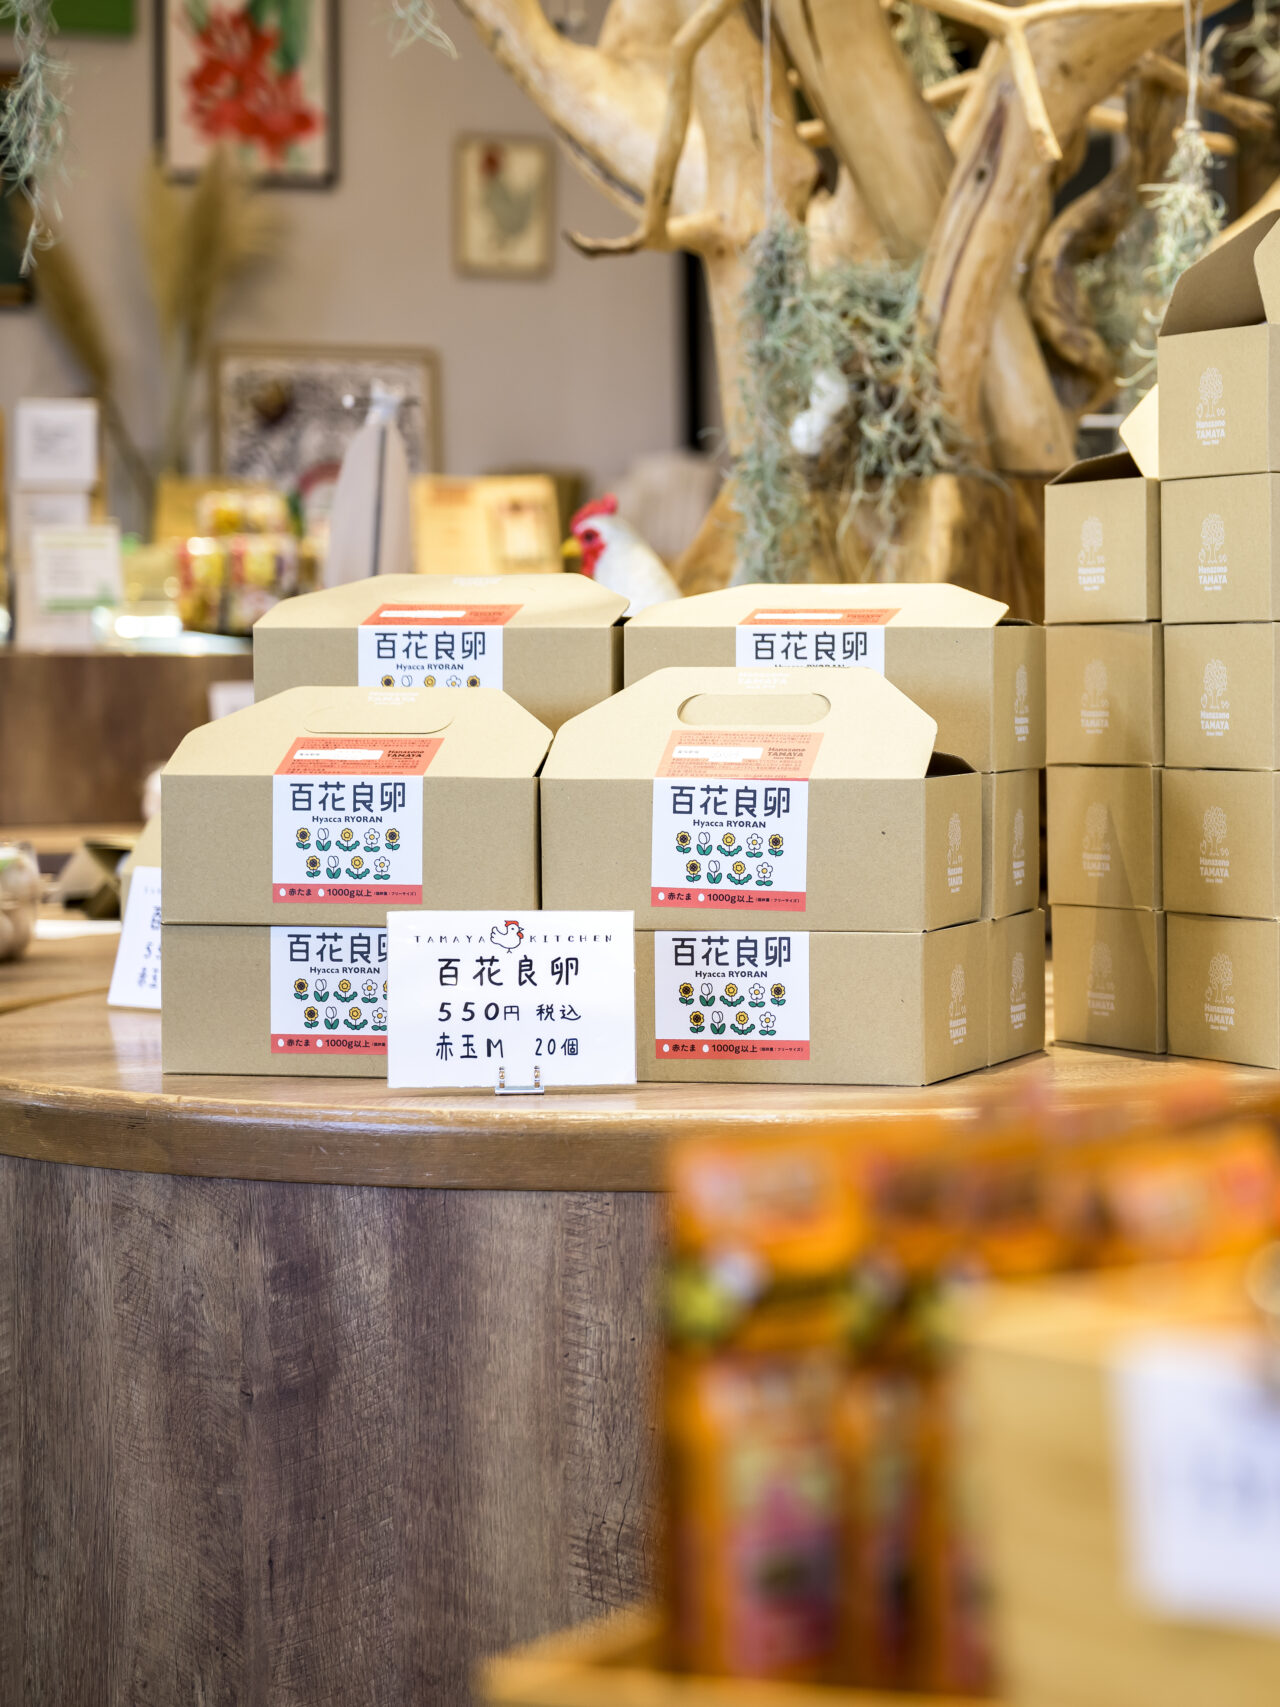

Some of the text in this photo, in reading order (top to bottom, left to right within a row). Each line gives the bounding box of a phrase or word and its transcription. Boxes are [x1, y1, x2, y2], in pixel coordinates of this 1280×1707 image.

[1196, 428, 1225, 440] TAMAYA
[1198, 575, 1228, 585] TAMAYA
[375, 630, 486, 660] 百花良卵
[753, 631, 867, 661] 百花良卵
[396, 663, 425, 671] Hyacca
[1200, 720, 1230, 730] TAMAYA
[290, 781, 406, 812] 百花良卵
[670, 784, 790, 818] 百花良卵
[312, 816, 342, 824] Hyacca
[692, 819, 766, 828] Hyacca RYORAN
[1199, 866, 1230, 878] TAMAYA
[327, 888, 372, 898] 1000g以上
[668, 892, 692, 900] 赤たま
[707, 893, 754, 904] 1000g以上
[414, 934, 613, 943] TAMAYA KITCHEN
[672, 936, 791, 967] 百花良卵
[310, 967, 340, 975] Hyacca
[438, 954, 579, 986] 百花良卵
[695, 971, 726, 979] Hyacca
[438, 1002, 582, 1022] 550円 税込
[1204, 1013, 1235, 1026] TAMAYA
[325, 1039, 370, 1049] 1000g以上
[436, 1032, 578, 1061] 赤玉M 20個
[672, 1044, 696, 1052] 赤たま
[711, 1044, 758, 1054] 1000g以上
